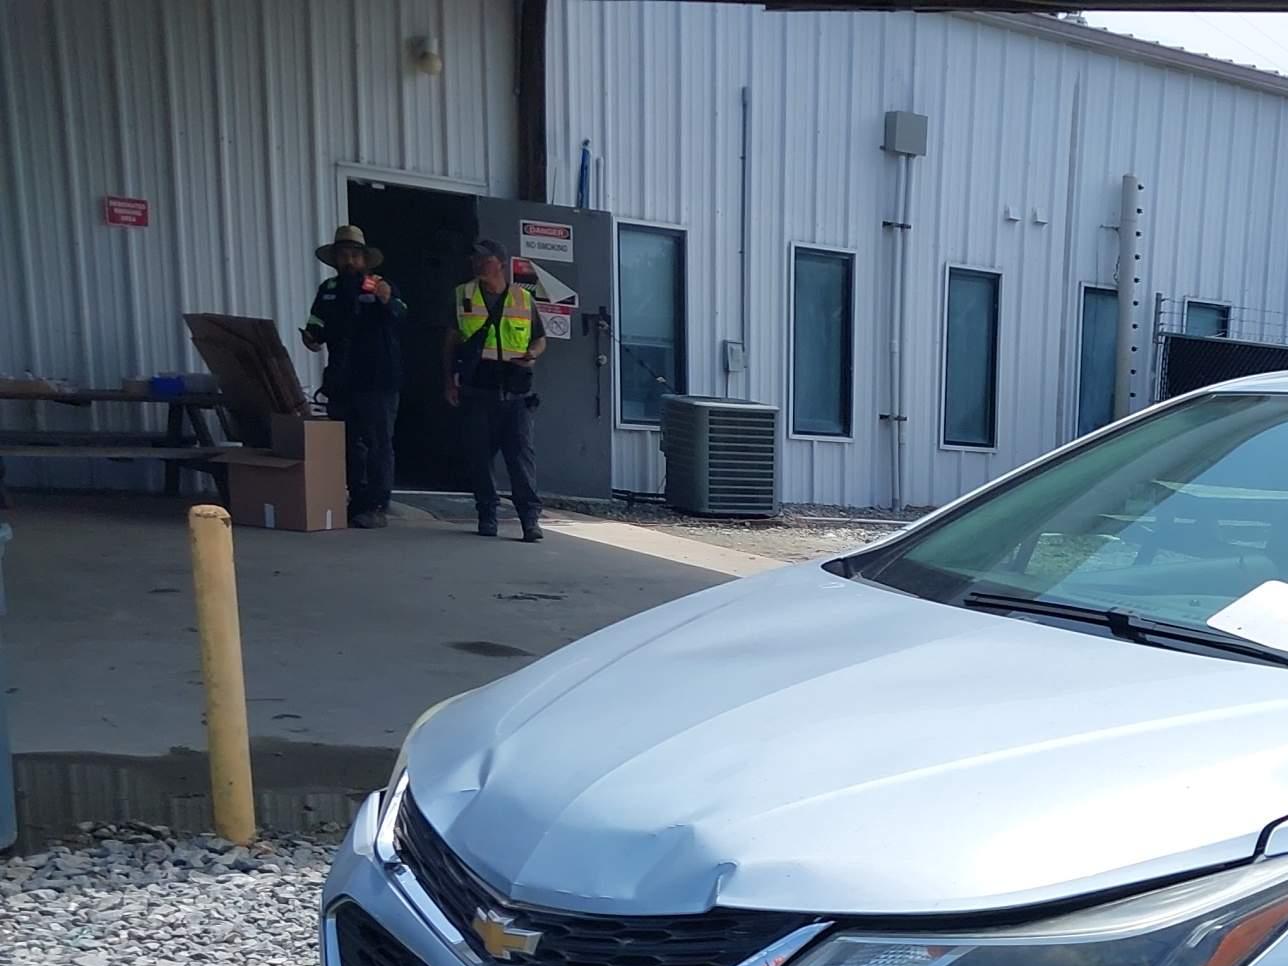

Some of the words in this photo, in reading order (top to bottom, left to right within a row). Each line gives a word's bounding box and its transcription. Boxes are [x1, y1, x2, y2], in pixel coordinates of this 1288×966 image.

[528, 226, 564, 237] DANGER
[526, 241, 536, 249] NO
[537, 242, 569, 253] SMOKING
